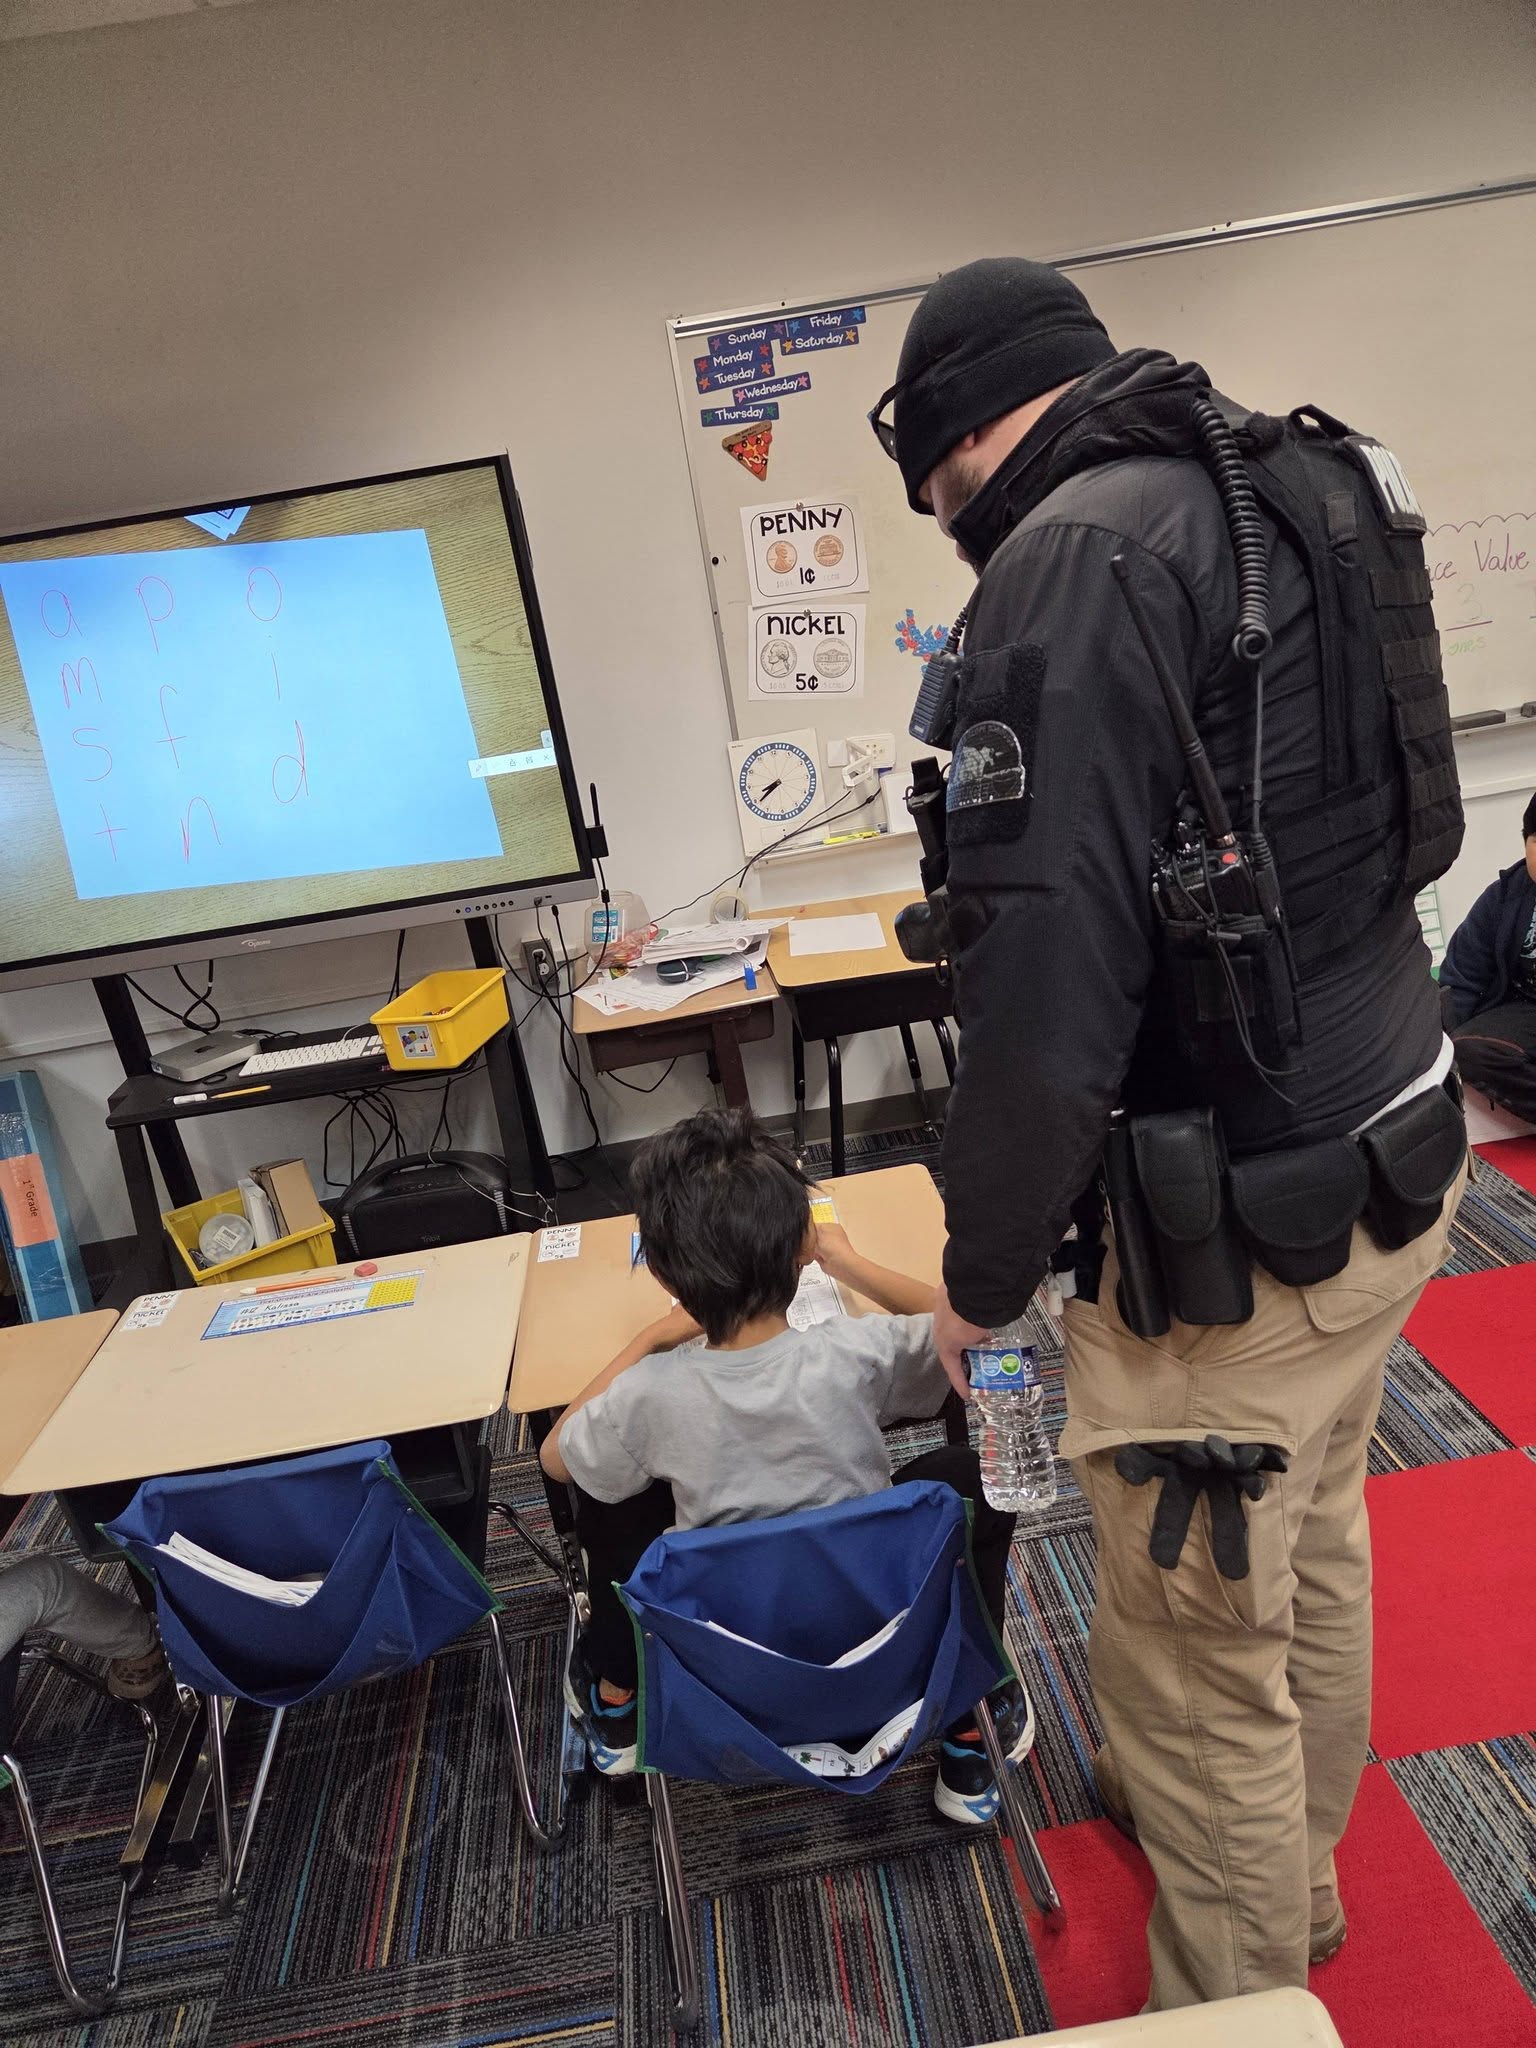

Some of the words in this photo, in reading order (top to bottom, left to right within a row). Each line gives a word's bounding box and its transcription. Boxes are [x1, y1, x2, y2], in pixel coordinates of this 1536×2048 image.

[809, 313, 842, 329] Friday
[727, 328, 767, 345] Sunday
[795, 333, 844, 349] Saturday
[713, 350, 753, 367] Monday
[714, 367, 756, 385] Tuesday
[744, 378, 800, 398] Wednesday
[715, 408, 764, 421] Thursday
[760, 507, 843, 537] PENNY
[1474, 533, 1530, 572] Value
[135, 576, 174, 653] p
[795, 673, 819, 691] 5¢
[272, 720, 309, 803] d
[181, 797, 221, 864] n
[25, 1191, 39, 1217] Grade
[546, 1227, 578, 1235] PENNY
